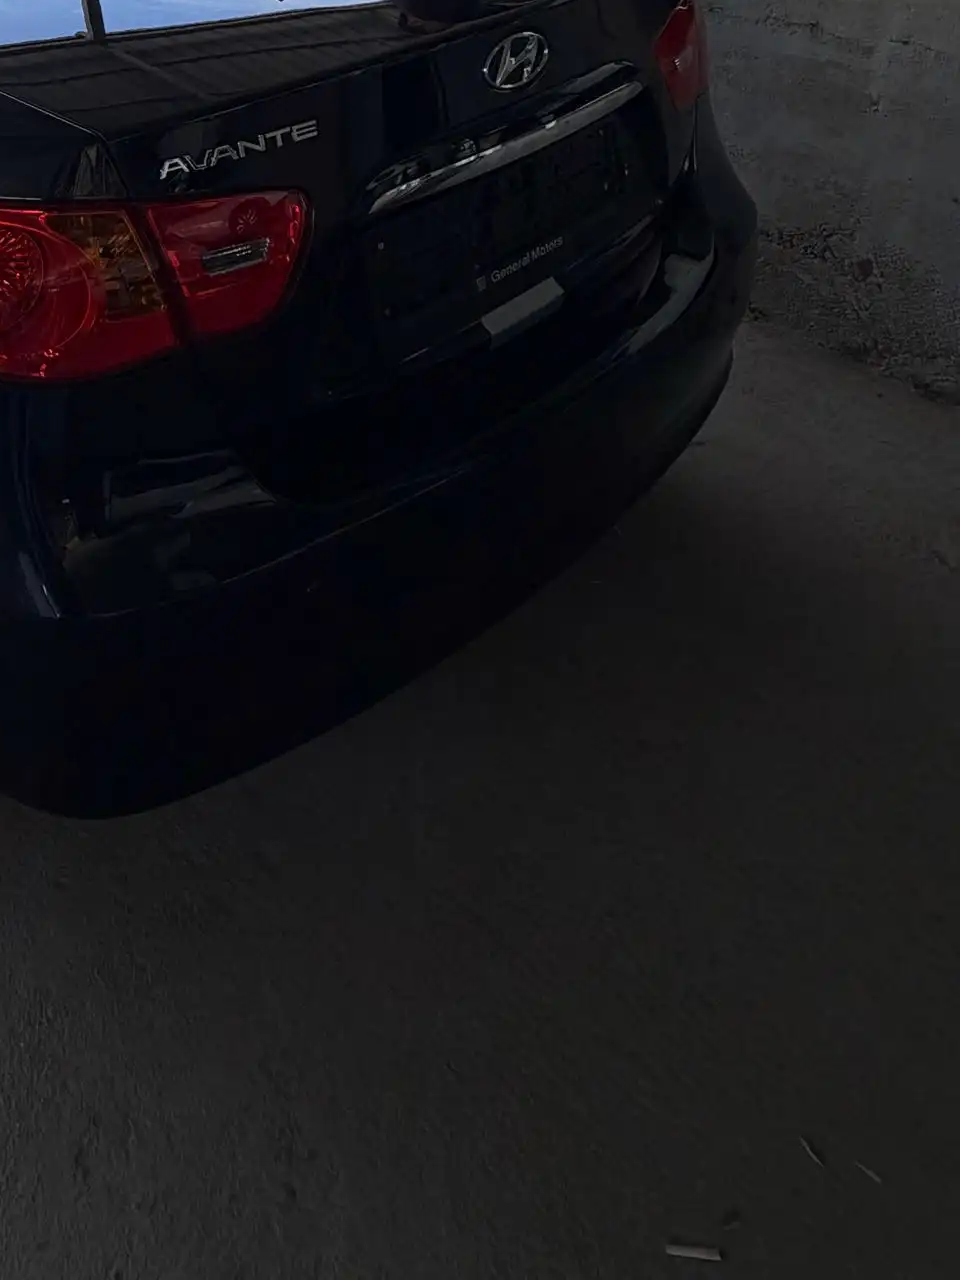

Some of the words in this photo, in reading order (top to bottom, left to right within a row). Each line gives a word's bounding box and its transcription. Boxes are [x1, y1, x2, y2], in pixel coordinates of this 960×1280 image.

[159, 120, 319, 180] AVANTE
[490, 252, 531, 283] General
[530, 236, 563, 262] Motors
